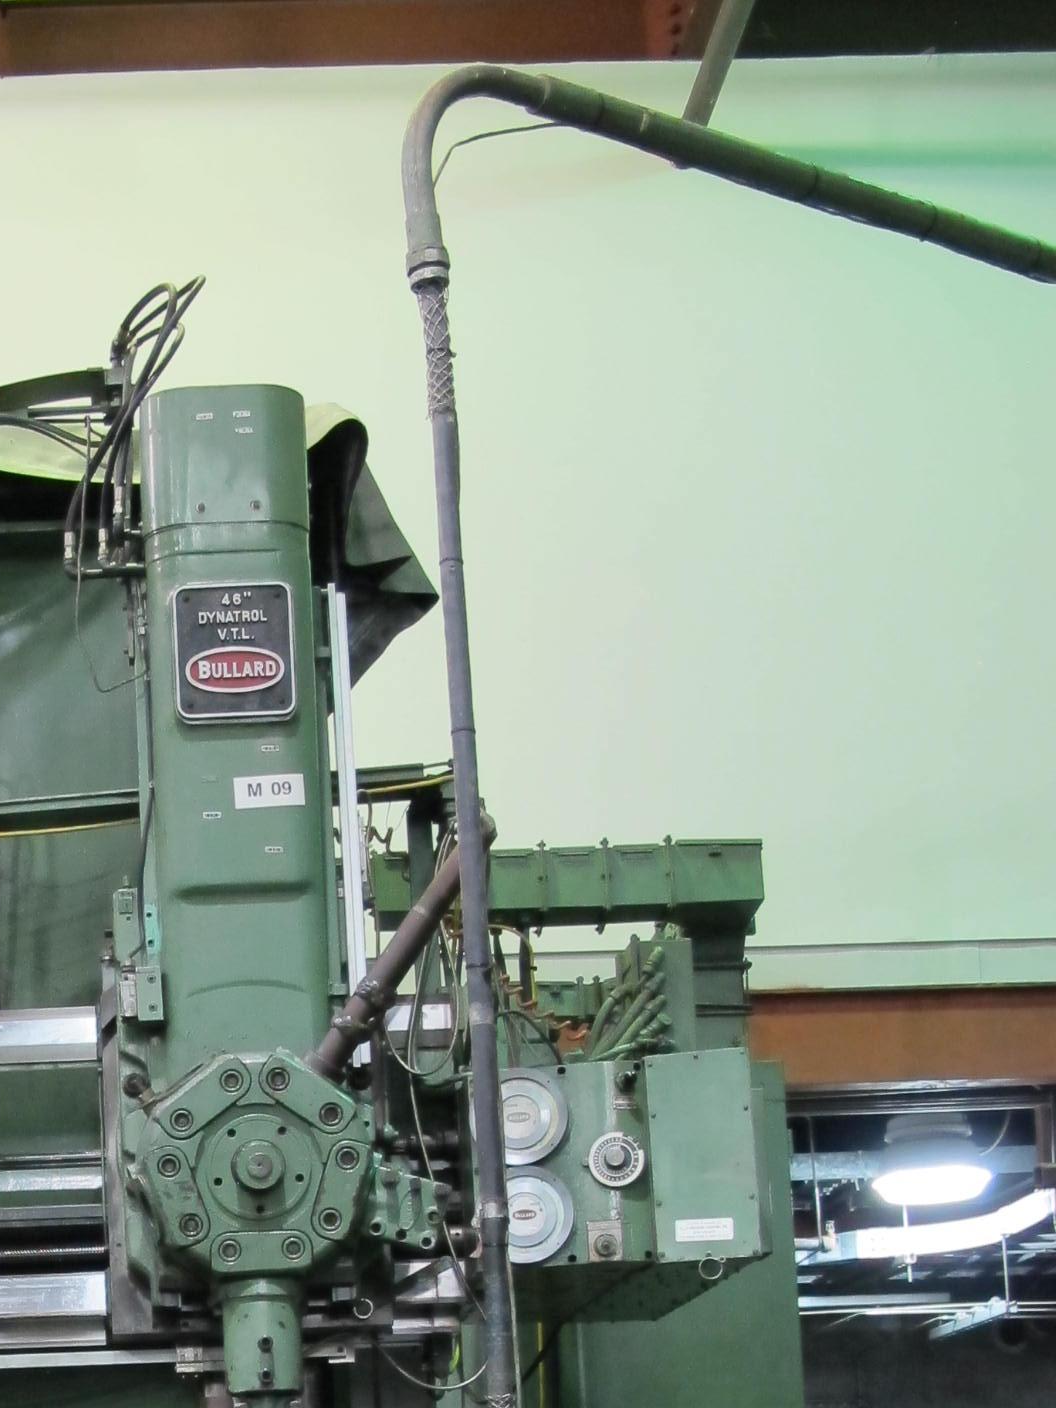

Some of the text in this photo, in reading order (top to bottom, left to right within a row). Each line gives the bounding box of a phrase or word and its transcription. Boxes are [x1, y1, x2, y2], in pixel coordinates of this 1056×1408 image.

[198, 609, 268, 625] DYNATROL
[217, 628, 255, 640] V.T.L.
[197, 660, 277, 680] BULLARD
[247, 781, 292, 797] M 09
